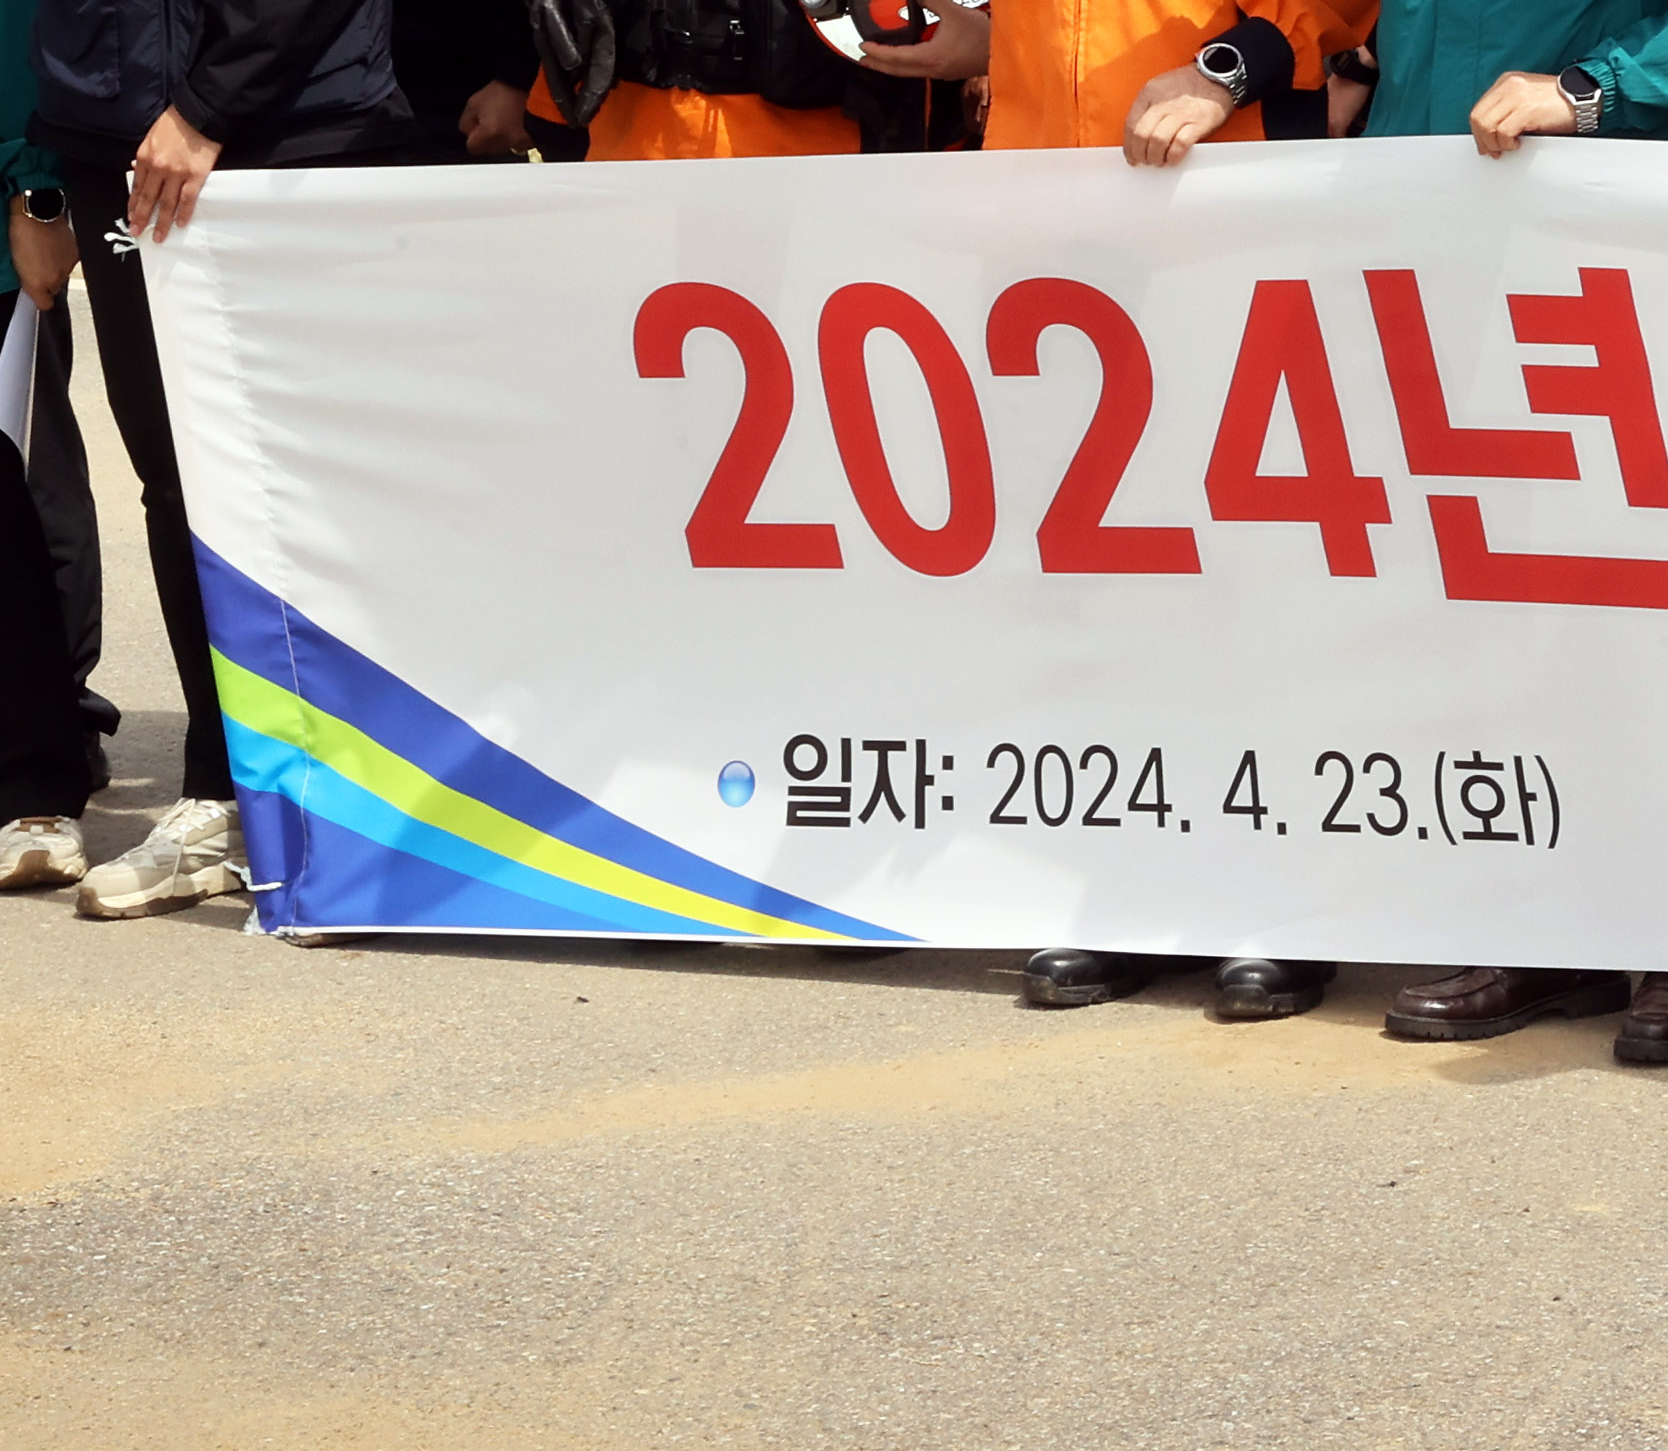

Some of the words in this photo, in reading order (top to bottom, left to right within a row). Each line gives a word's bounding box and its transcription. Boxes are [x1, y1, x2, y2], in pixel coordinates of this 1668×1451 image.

[782, 734, 955, 829] 일자:
[986, 743, 1191, 834] 2024.
[1221, 750, 1288, 836] 4.
[1313, 750, 1561, 850] 23.(화)
